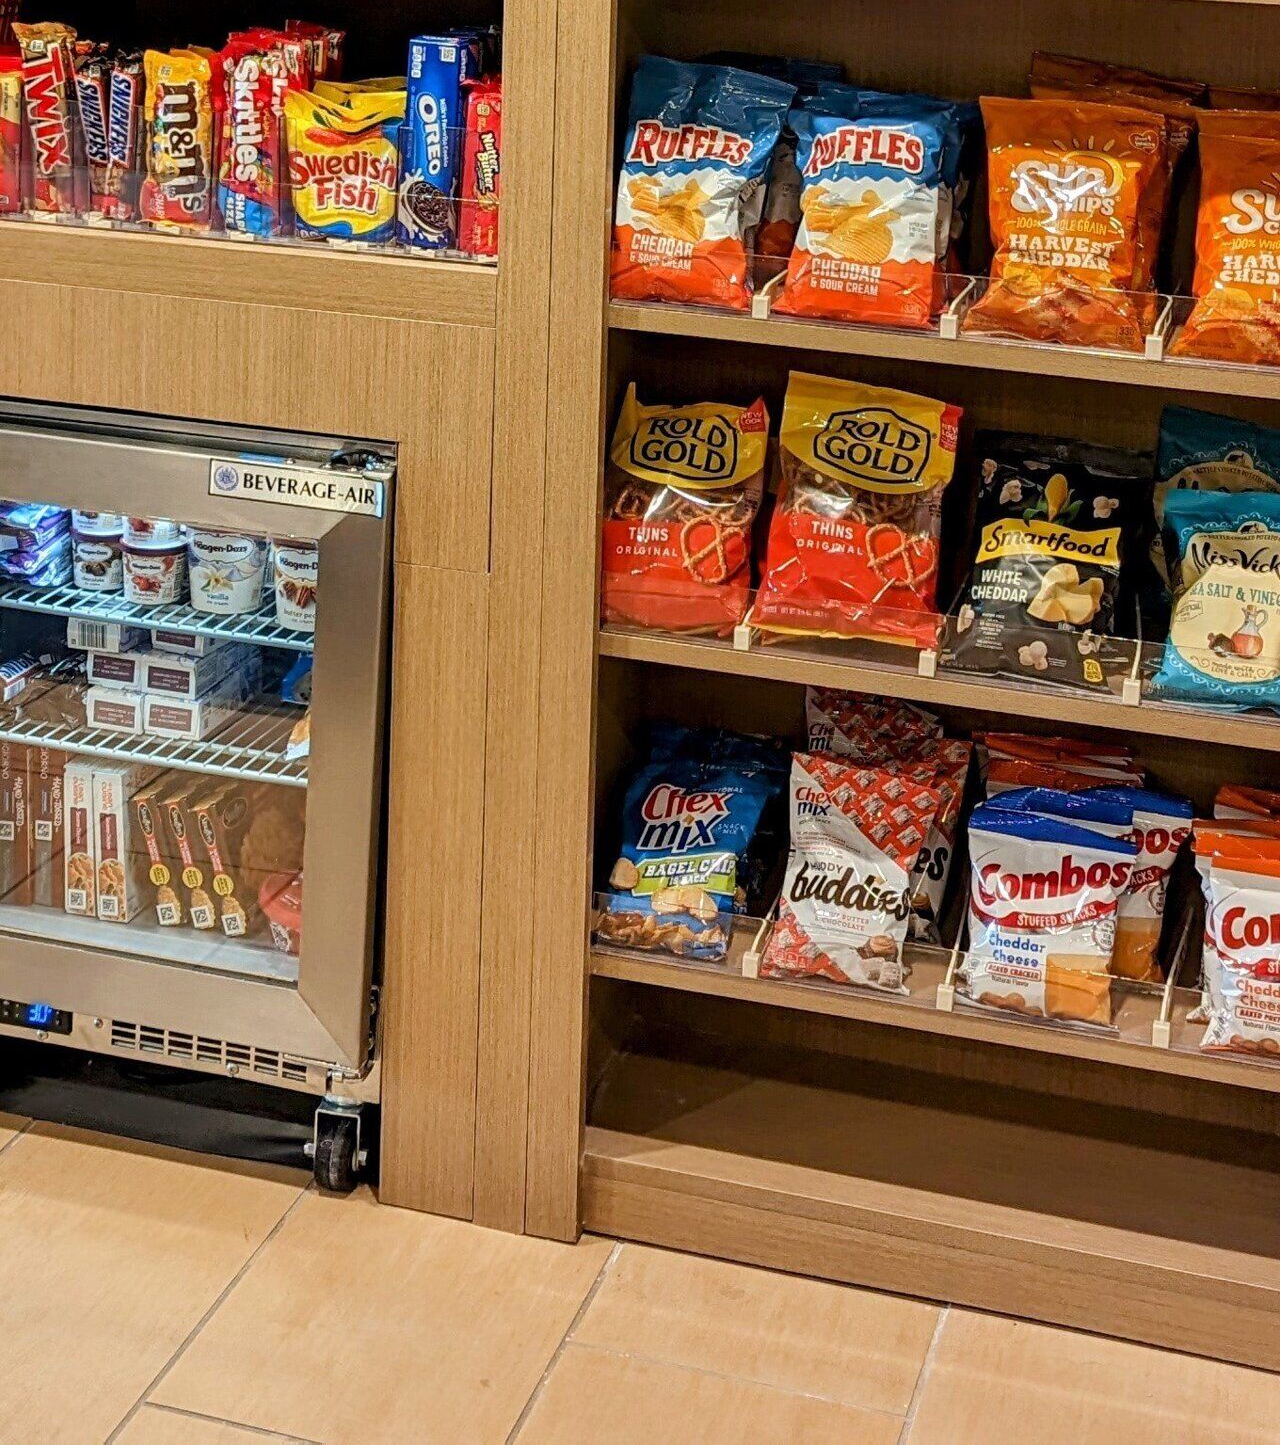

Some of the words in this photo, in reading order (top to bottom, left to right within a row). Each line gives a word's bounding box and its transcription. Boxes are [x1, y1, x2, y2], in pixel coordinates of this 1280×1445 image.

[22, 42, 71, 175] TWIX
[76, 75, 108, 164] SNICKERS
[418, 94, 441, 176] OREO
[629, 121, 751, 167] RUFFLES
[804, 127, 923, 176] RUFFLES
[288, 150, 397, 190] Swedish
[311, 179, 379, 214] Fish
[631, 233, 694, 255] CHEDDAR
[1009, 235, 1115, 259] HARVEST
[1231, 238, 1257, 250] 100%
[811, 258, 881, 283] CHEDDAR
[1008, 250, 1111, 272] CHEDDAR
[810, 277, 818, 288] &
[819, 278, 844, 292] SOUR
[845, 281, 878, 296] CREAM
[648, 416, 728, 447] ROLD
[838, 418, 921, 453] ROLD
[640, 439, 726, 474] GOLD
[823, 435, 914, 476] GOLD
[243, 471, 376, 506] BEVERAGE-AIR
[628, 526, 669, 542] THINS
[810, 519, 854, 540] THINS
[984, 526, 1111, 559] Smartfood
[615, 544, 679, 558] ORIGINAL
[796, 537, 863, 556] ORIGINAL
[1191, 542, 1241, 572] Miss
[980, 569, 1023, 586] WHITE
[970, 585, 1028, 604] CHEDDAR
[642, 785, 733, 820] Chex
[794, 787, 834, 804] Chex
[636, 814, 718, 853] mix
[789, 859, 912, 921] buddies
[978, 854, 1132, 906] Combos
[1016, 911, 1058, 927] STUFFED
[1059, 904, 1097, 924] SNACKS
[988, 932, 1047, 953] Cheddar
